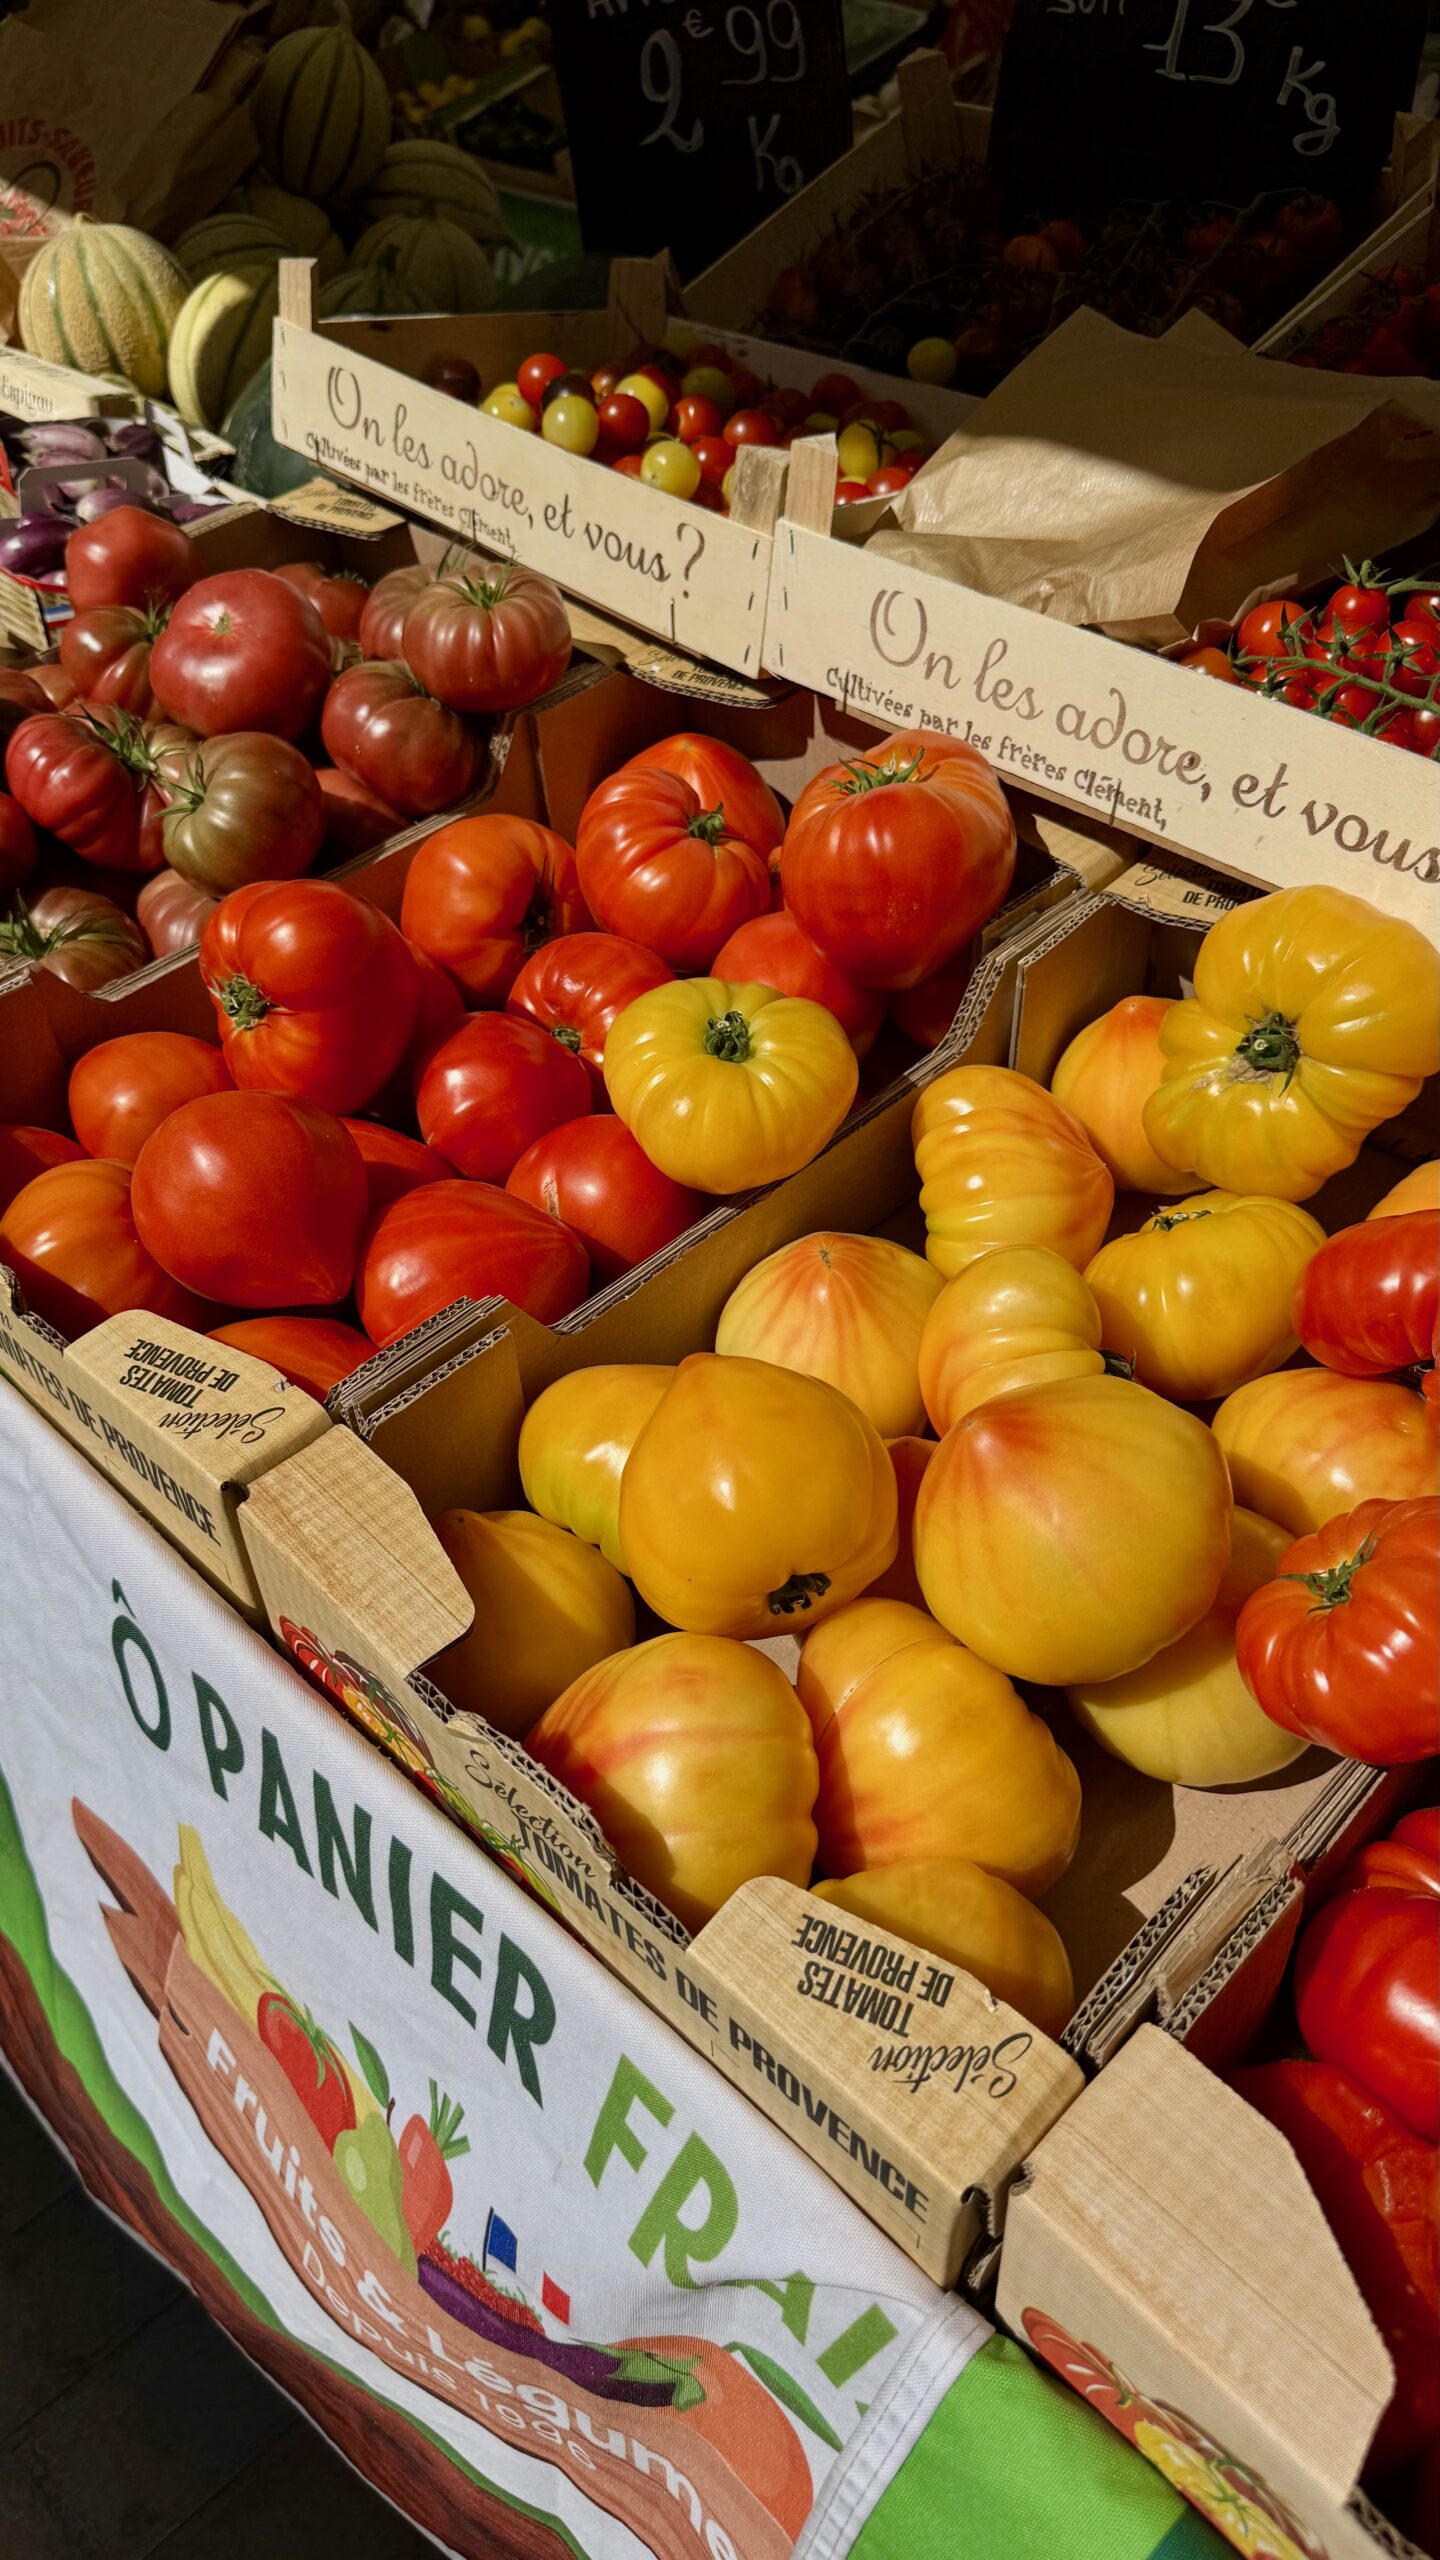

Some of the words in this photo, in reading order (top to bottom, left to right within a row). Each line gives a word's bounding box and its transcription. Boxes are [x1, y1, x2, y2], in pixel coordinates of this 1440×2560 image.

[1277, 46, 1342, 157] Kg
[328, 366, 385, 447] On
[392, 403, 434, 470] les
[441, 440, 534, 529] adore,
[544, 494, 576, 539] et
[364, 462, 391, 485] par
[392, 471, 410, 496] les
[413, 483, 455, 518] frères
[826, 666, 914, 718] Cultivées
[918, 709, 959, 735] par
[963, 721, 993, 750] les
[997, 735, 1068, 781] frères
[870, 589, 961, 690] On
[973, 638, 1044, 720] les
[1055, 687, 1212, 804] adore,
[1231, 763, 1289, 818] et
[1299, 800, 1440, 883] vous
[1182, 891, 1204, 905] DE
[119, 1364, 204, 1408] TOMATES
[124, 1338, 217, 1385] PROVENCE
[207, 1368, 241, 1393] DE
[66, 1386, 102, 1440] DE
[98, 1414, 222, 1547] PROVENCE
[159, 1406, 286, 1444] Sélection
[111, 1577, 171, 1752] Ô
[191, 1670, 557, 2110] PANIER
[465, 1750, 596, 1879] Sélection
[791, 1913, 920, 1994] PROVENCE
[797, 1960, 914, 2038] TOMATES
[916, 1965, 955, 2008] DE
[511, 1807, 667, 1981] TOMATES
[675, 1967, 719, 2033] DE
[728, 2016, 929, 2224] PROVENCE
[867, 2032, 1033, 2099] Sélection
[207, 2027, 346, 2267] Fruits
[357, 2270, 408, 2337] &
[303, 2241, 457, 2390] Depuis
[474, 2389, 597, 2470] 1996
